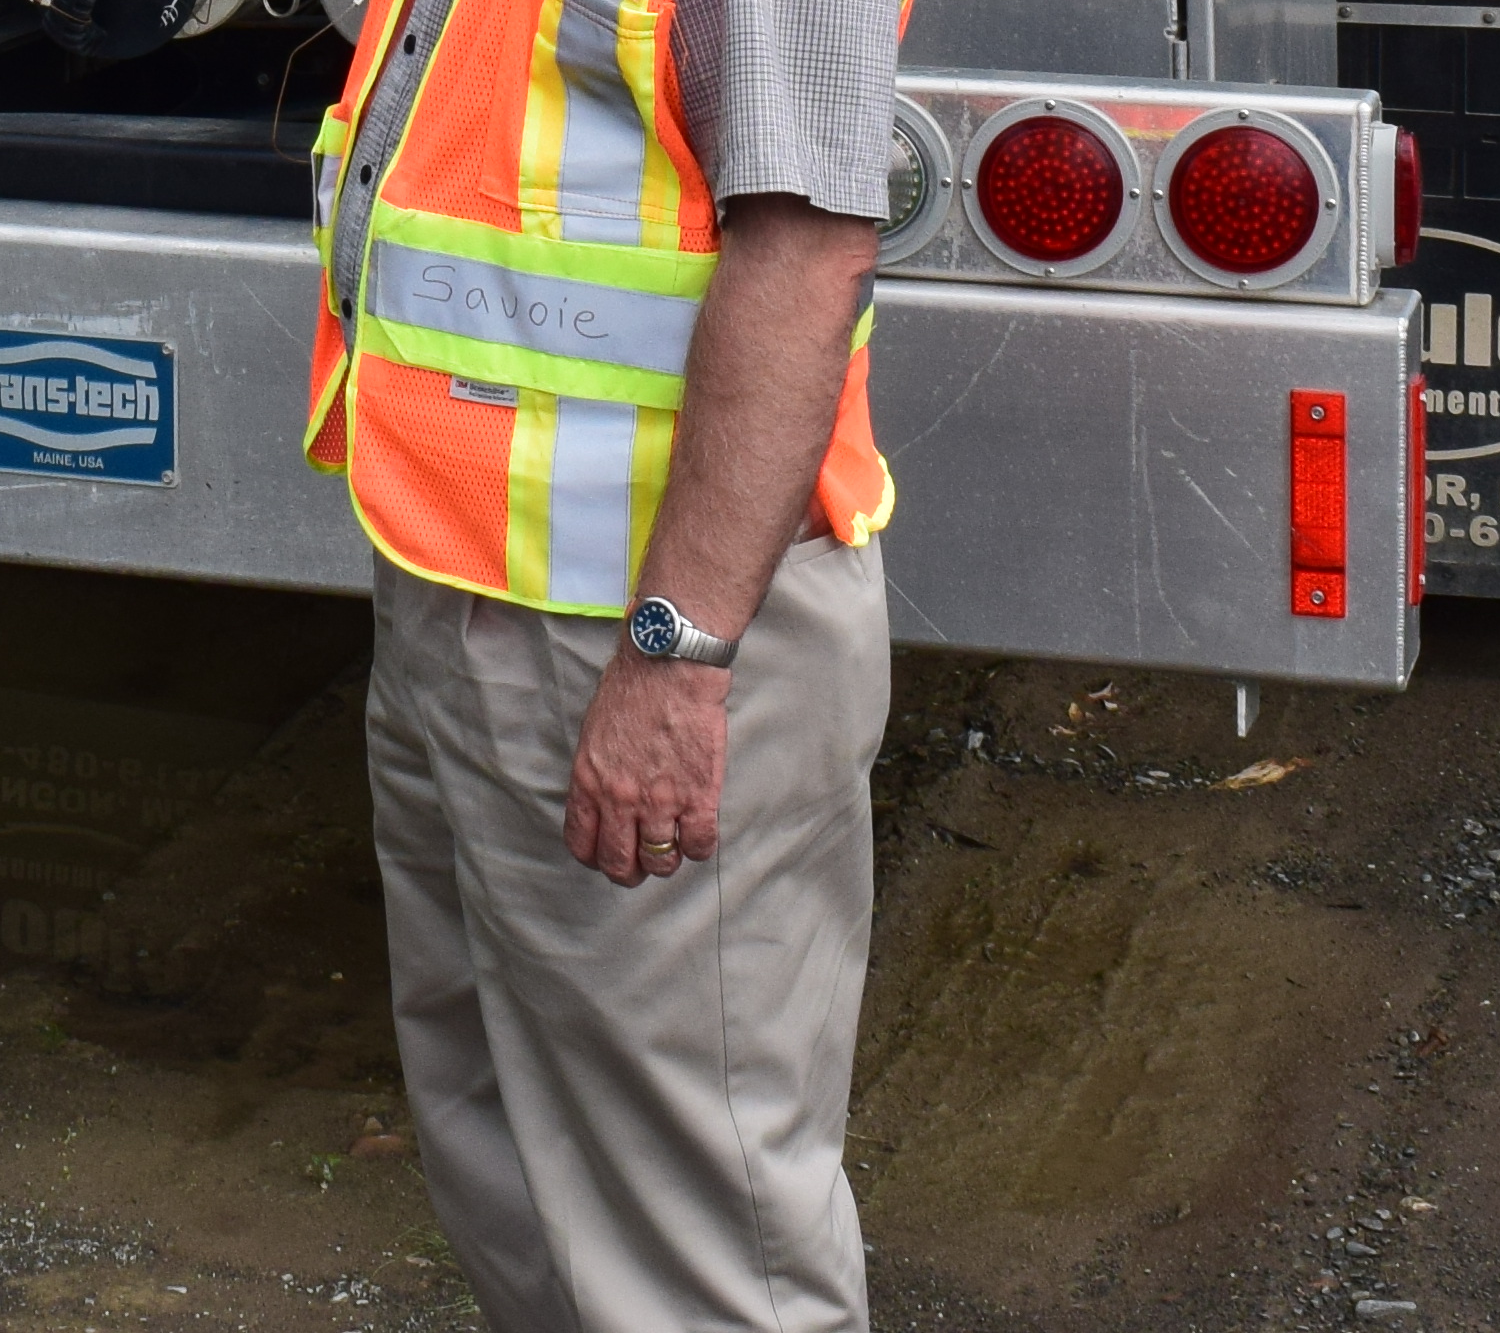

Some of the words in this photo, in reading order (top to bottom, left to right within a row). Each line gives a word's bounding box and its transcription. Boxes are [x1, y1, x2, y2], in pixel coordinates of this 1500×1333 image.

[412, 264, 609, 339] Savoie
[33, 451, 76, 469] MAINE,
[79, 452, 105, 470] USA
